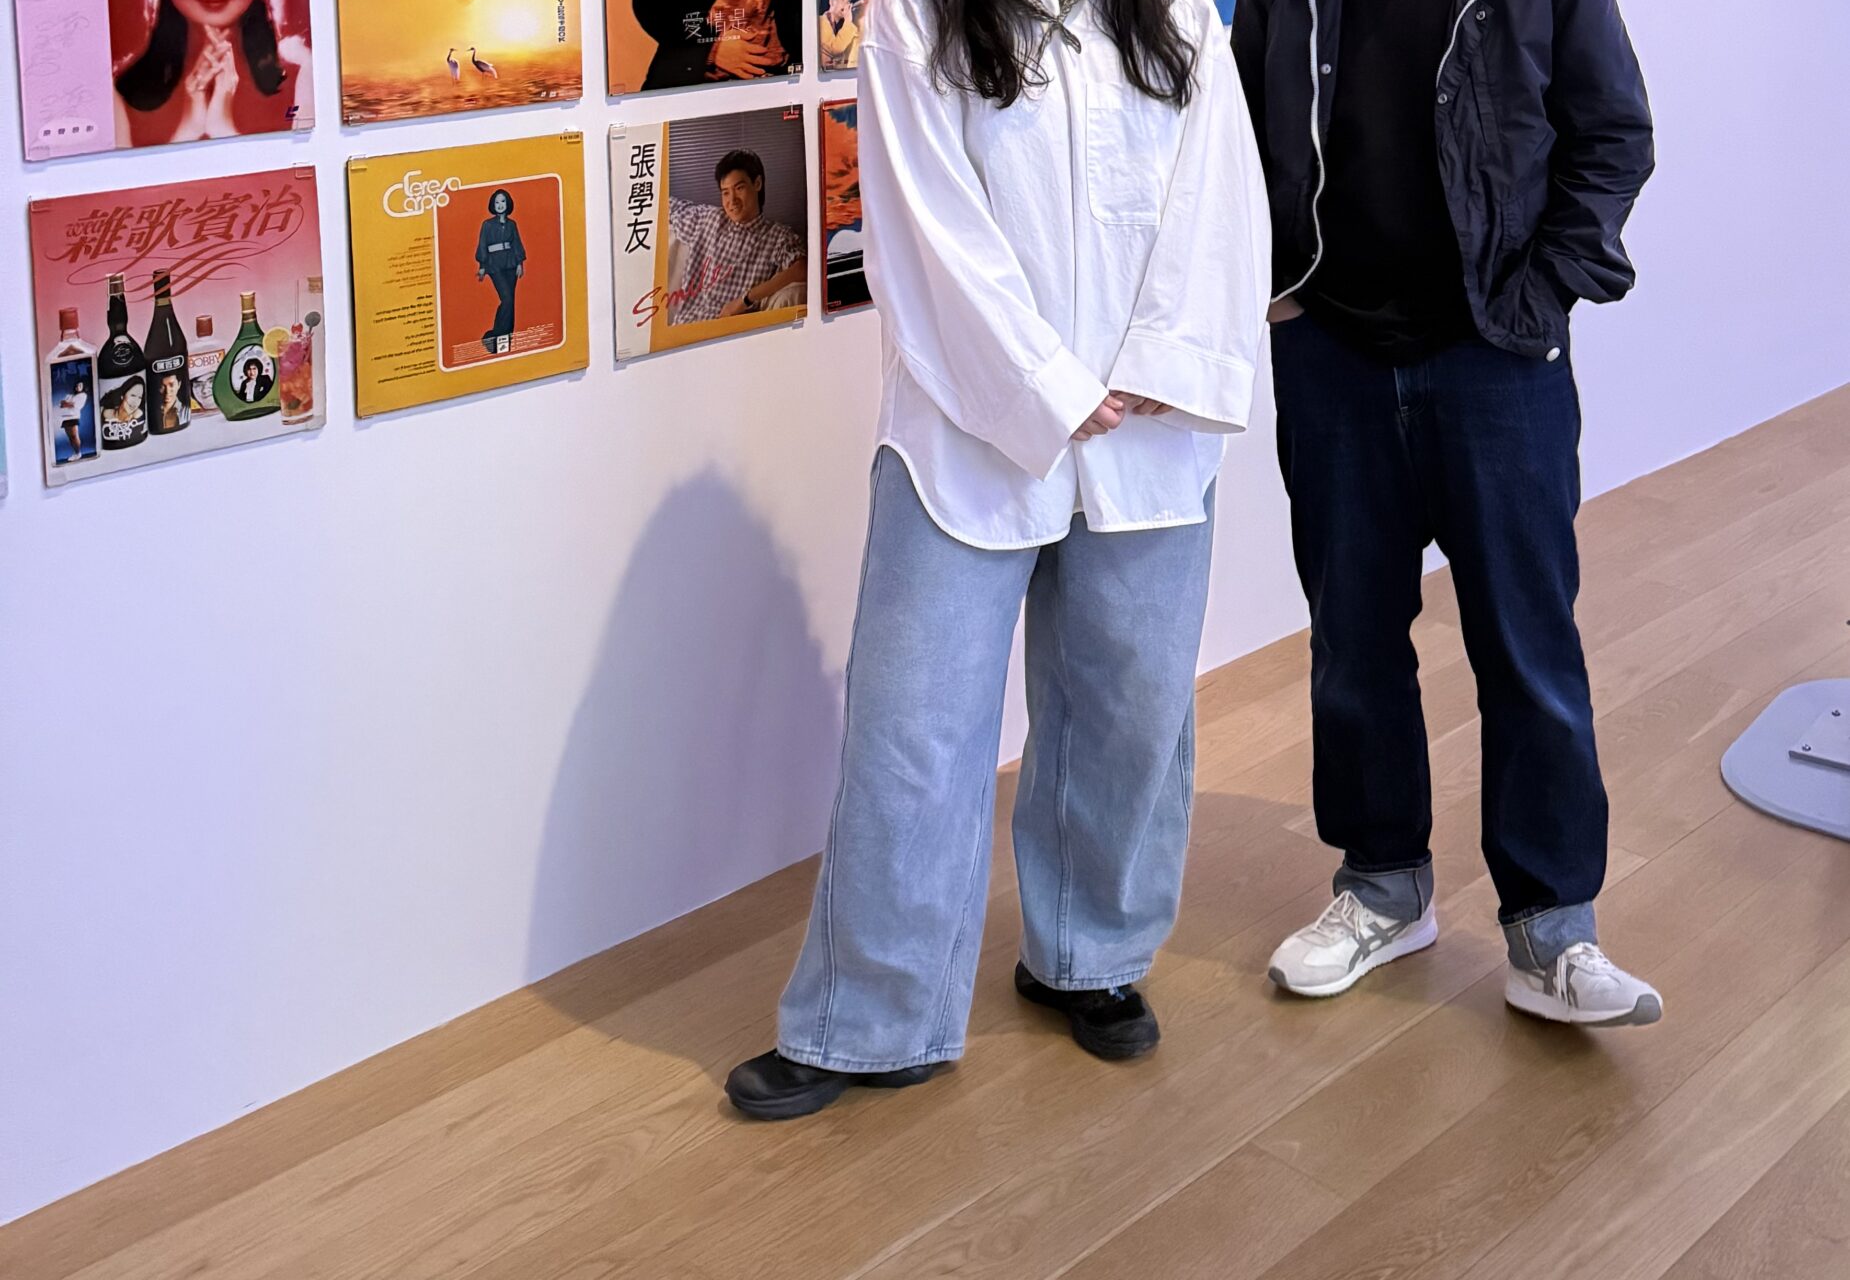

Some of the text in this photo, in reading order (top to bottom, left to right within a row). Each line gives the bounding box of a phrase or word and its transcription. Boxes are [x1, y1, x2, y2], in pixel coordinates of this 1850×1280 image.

[383, 182, 450, 219] Carpio
[403, 169, 462, 197] Teresa
[625, 143, 657, 254] 張學友
[632, 255, 734, 328] Smile
